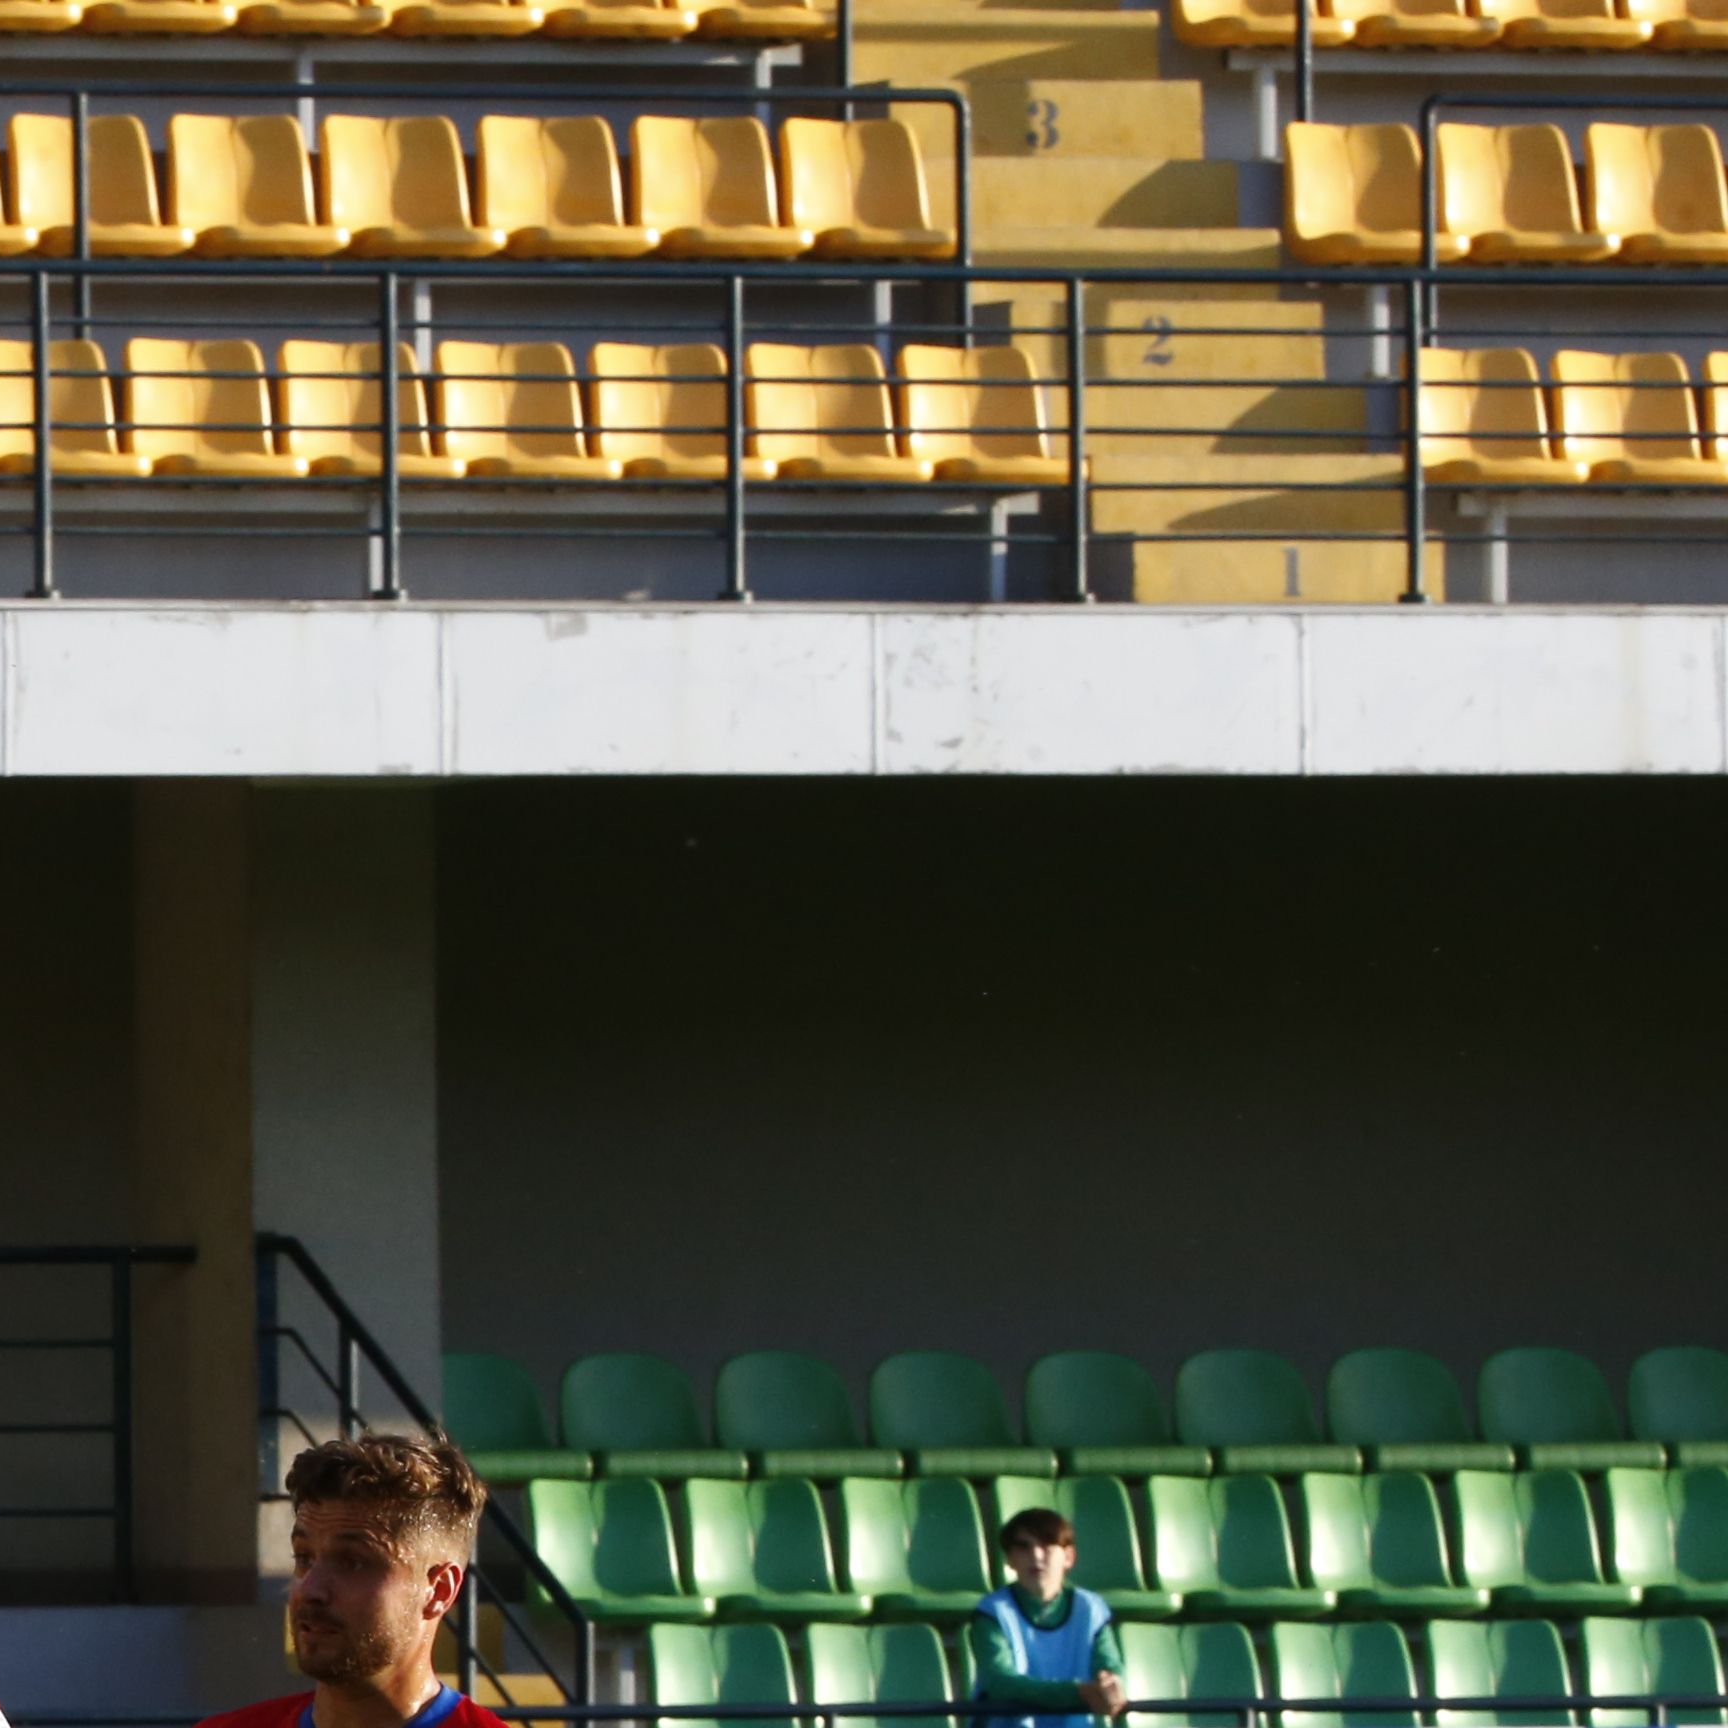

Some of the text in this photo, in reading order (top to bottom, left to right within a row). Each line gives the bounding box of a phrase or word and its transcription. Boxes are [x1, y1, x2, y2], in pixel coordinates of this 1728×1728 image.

[1024, 99, 1060, 150] 3
[1142, 315, 1176, 367] 2
[1282, 546, 1302, 597] 1
